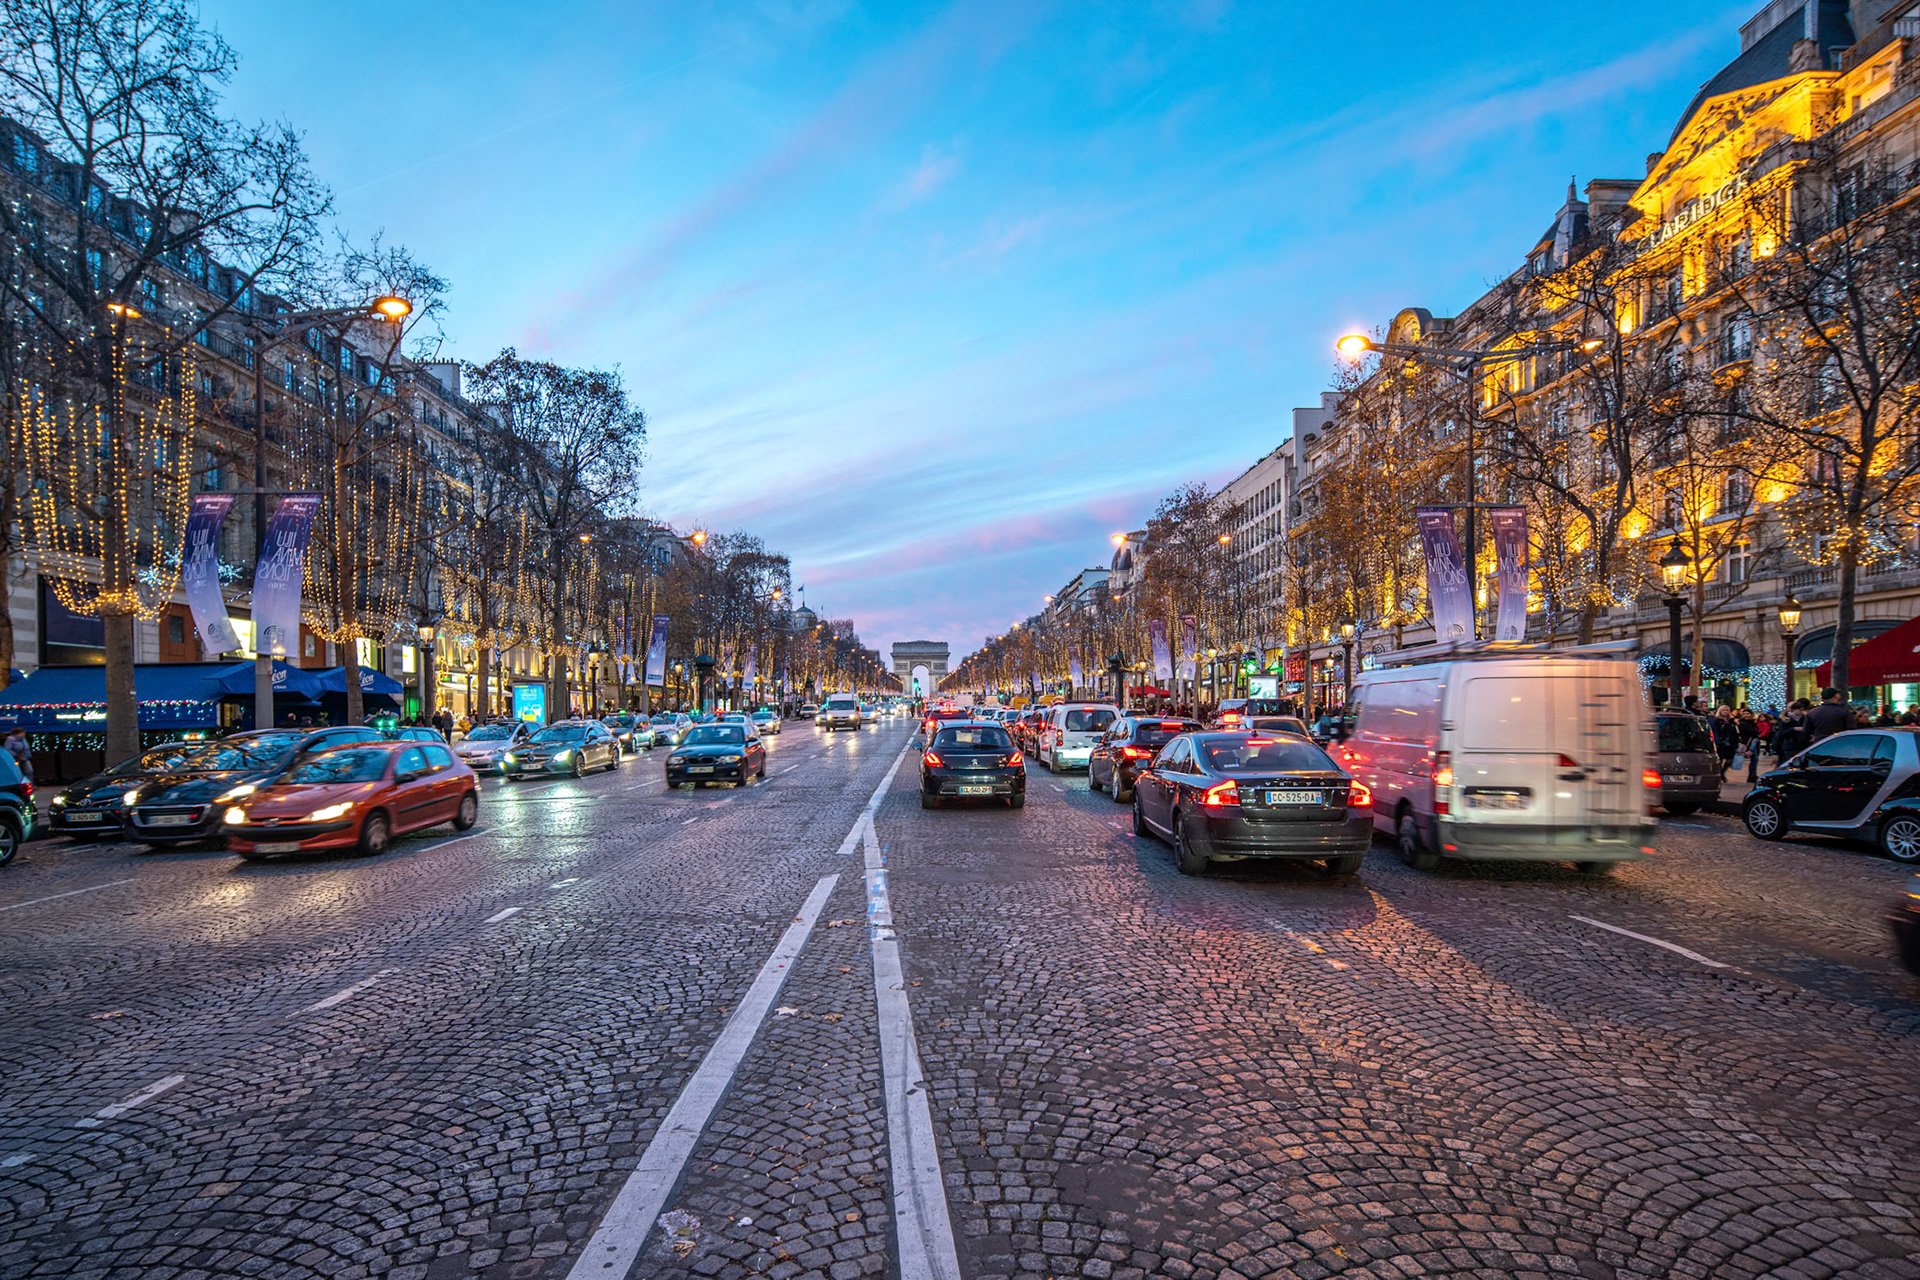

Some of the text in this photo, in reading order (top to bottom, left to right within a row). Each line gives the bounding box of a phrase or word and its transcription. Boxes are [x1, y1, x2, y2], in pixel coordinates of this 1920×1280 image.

[1636, 169, 1751, 257] CLARIDGE
[1433, 542, 1451, 557] ILLU
[1428, 554, 1455, 574] MINA
[1437, 569, 1466, 587] TIONS
[271, 669, 287, 684] éon
[1272, 794, 1316, 803] CC-525-DA
